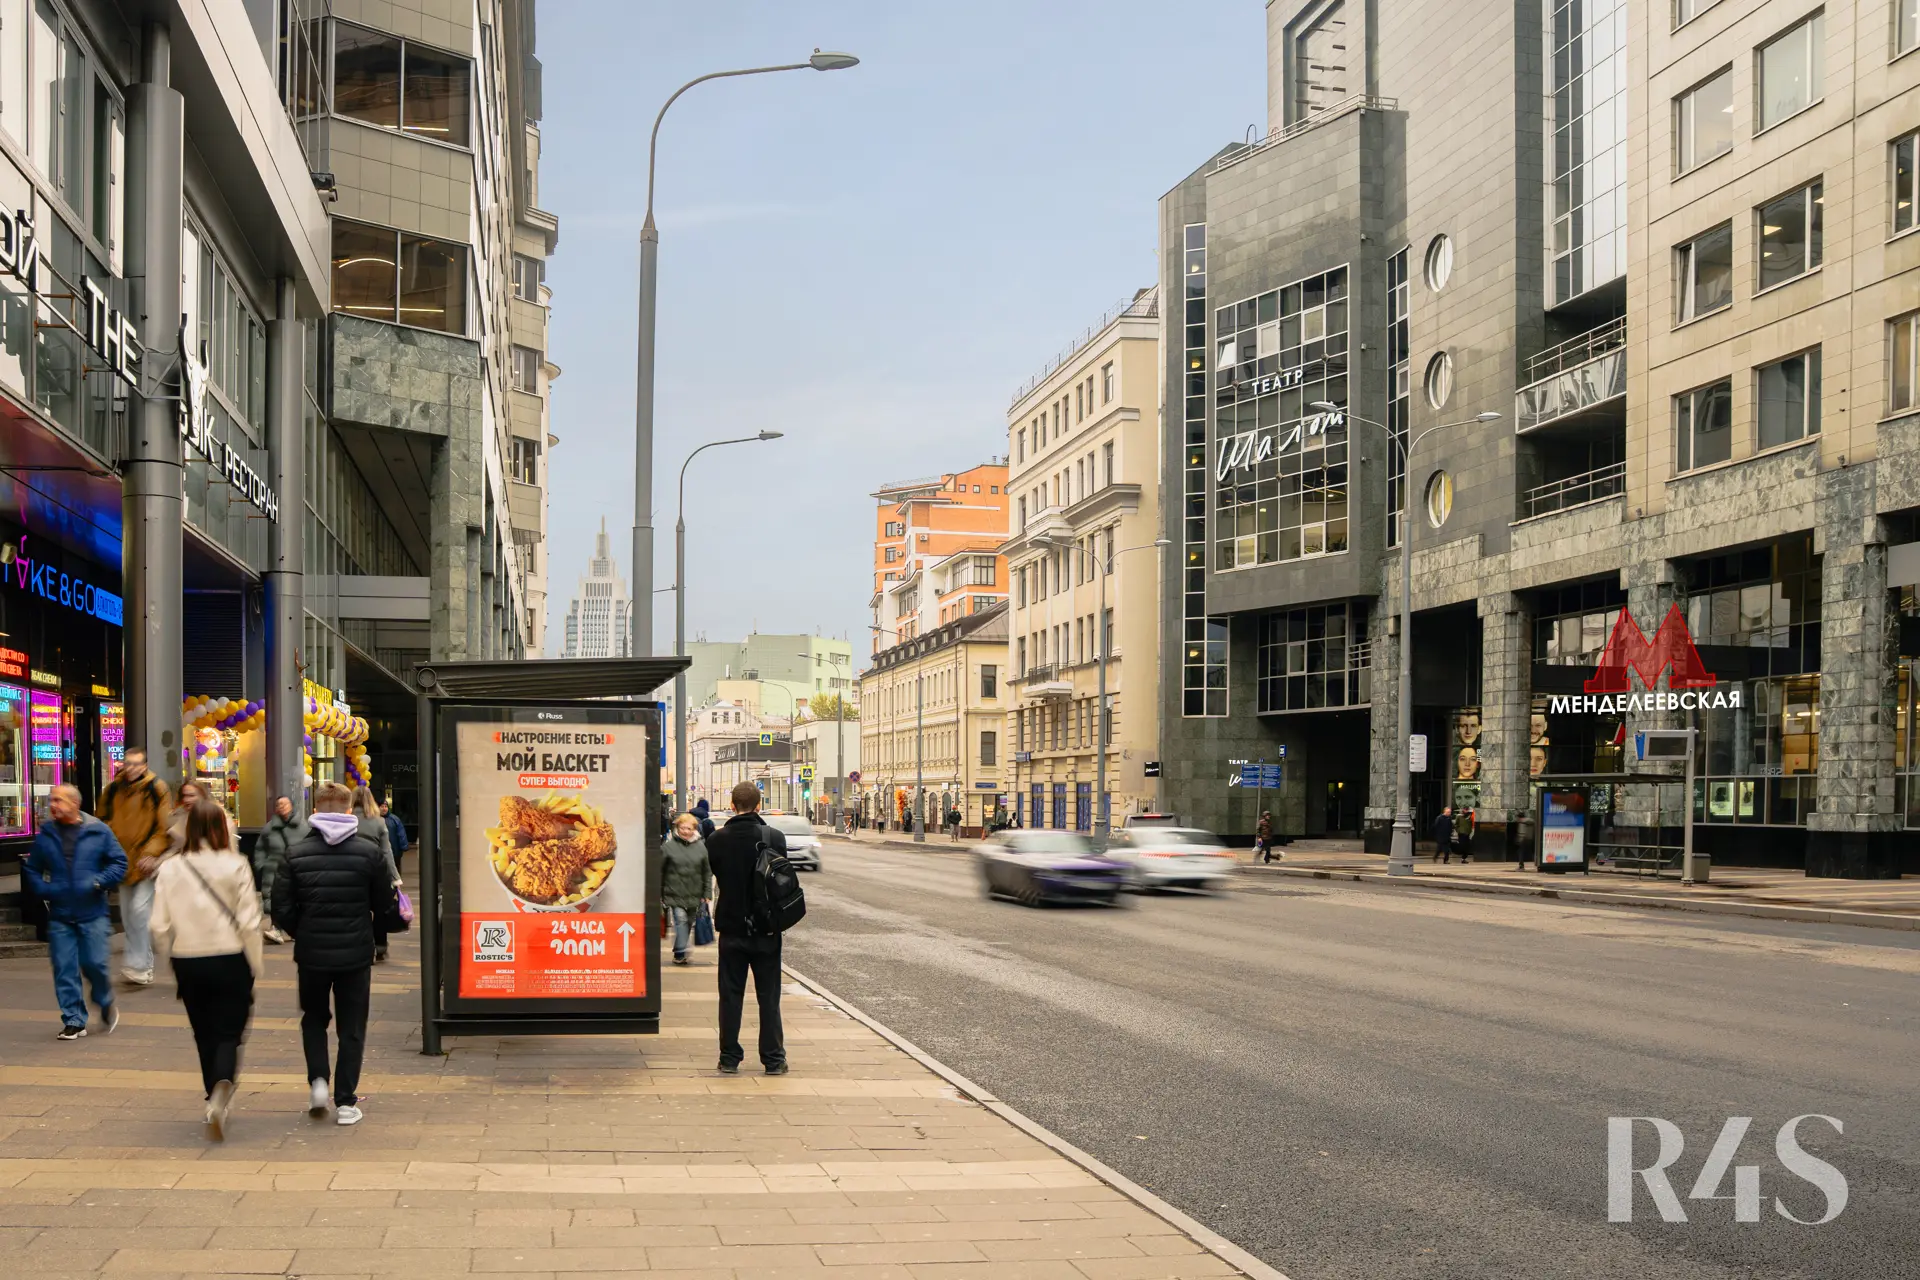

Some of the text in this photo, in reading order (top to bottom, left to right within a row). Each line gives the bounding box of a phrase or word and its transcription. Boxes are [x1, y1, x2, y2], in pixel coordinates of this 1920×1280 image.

[1252, 369, 1304, 396] ТЕАТР
[82, 275, 137, 386] THE
[223, 443, 279, 524] РЕСТОРАН
[545, 712, 563, 720] Russ
[501, 731, 605, 745] НАСТРОЕНИЕ ЕСТЬ!
[496, 746, 610, 772] МОЙ БАСКЕТ
[520, 776, 587, 788] СУПЕР ВЫГОДНО
[551, 920, 606, 935] 24 ЧАСА
